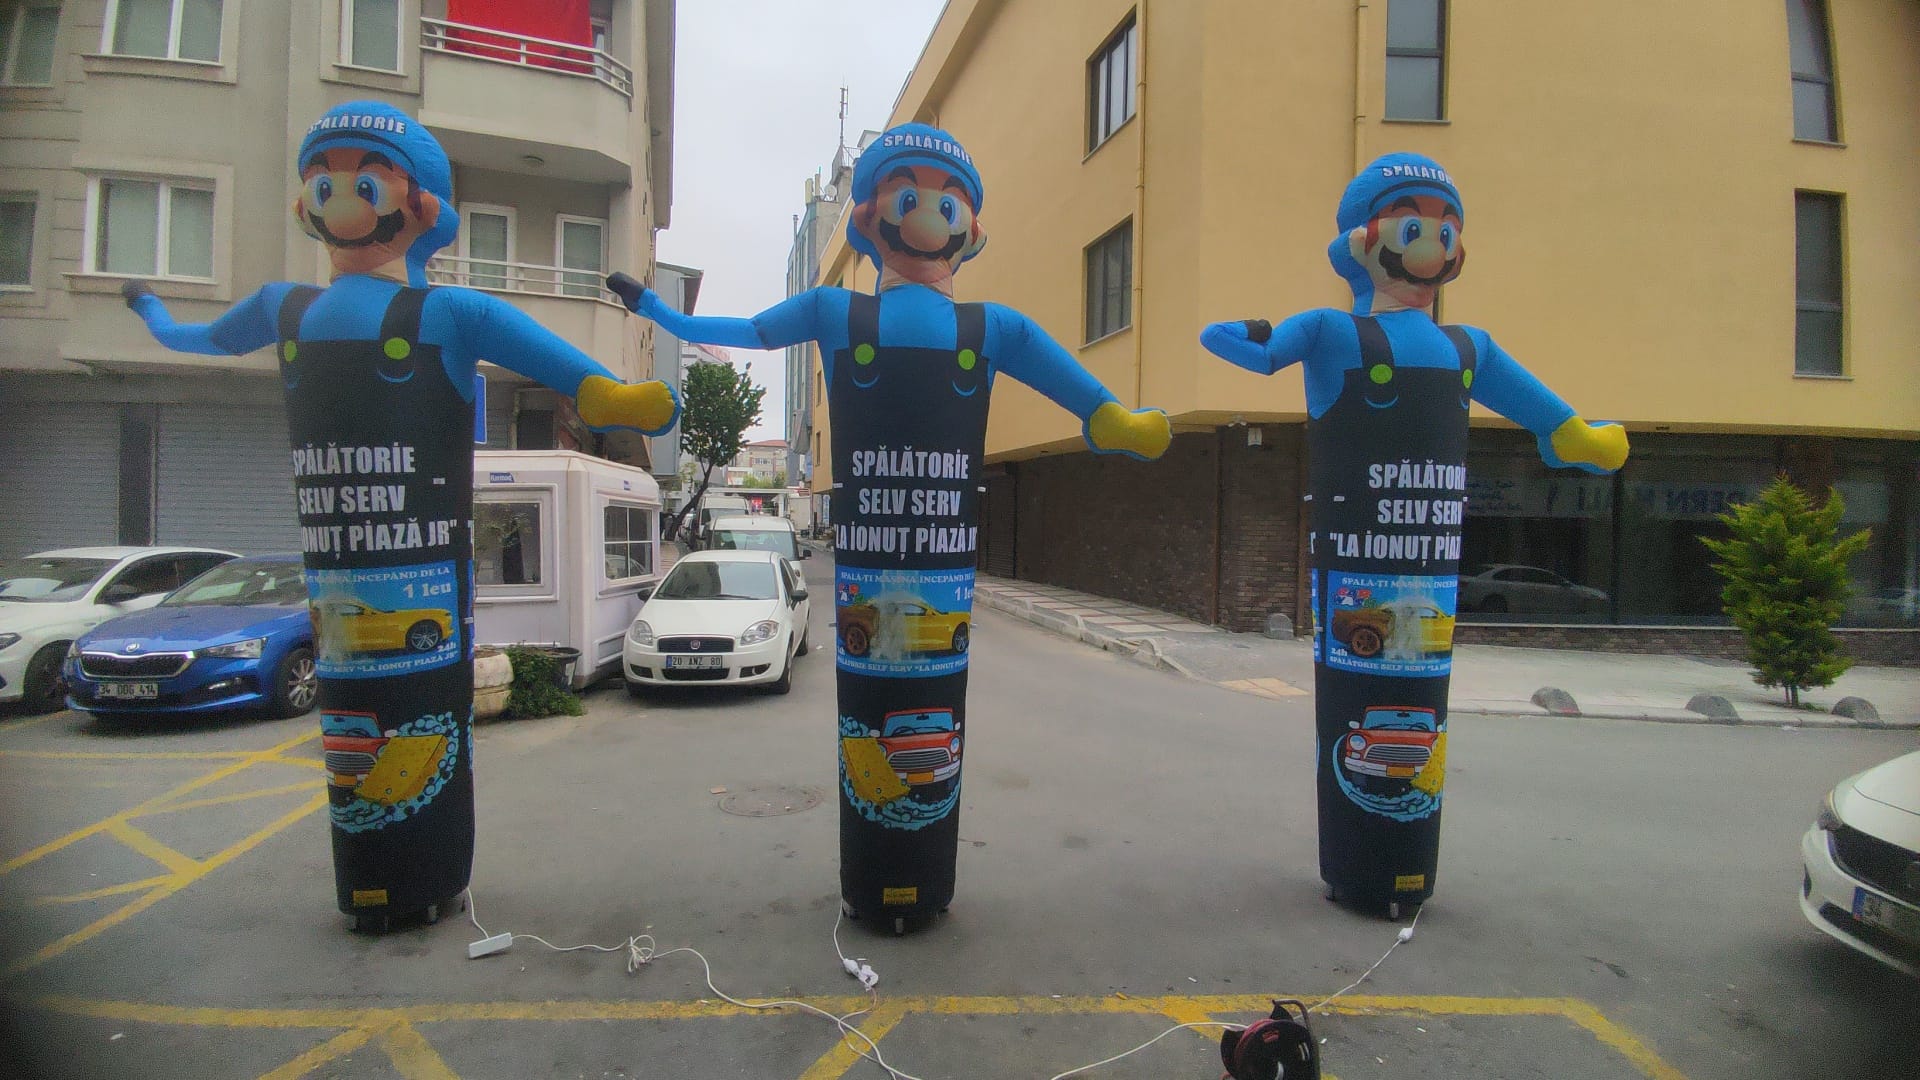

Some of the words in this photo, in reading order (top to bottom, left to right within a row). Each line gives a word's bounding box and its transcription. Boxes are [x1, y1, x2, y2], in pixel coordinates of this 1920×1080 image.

[300, 486, 335, 514] SELV
[340, 485, 406, 513] SERV
[858, 488, 907, 515] SELV
[911, 489, 961, 516] SERV
[1377, 499, 1428, 524] SELV
[1329, 532, 1359, 558] "LA
[437, 566, 450, 575] LA
[403, 583, 414, 599] 1
[422, 582, 451, 597] leu
[955, 586, 961, 600] 1
[673, 657, 682, 666] 20
